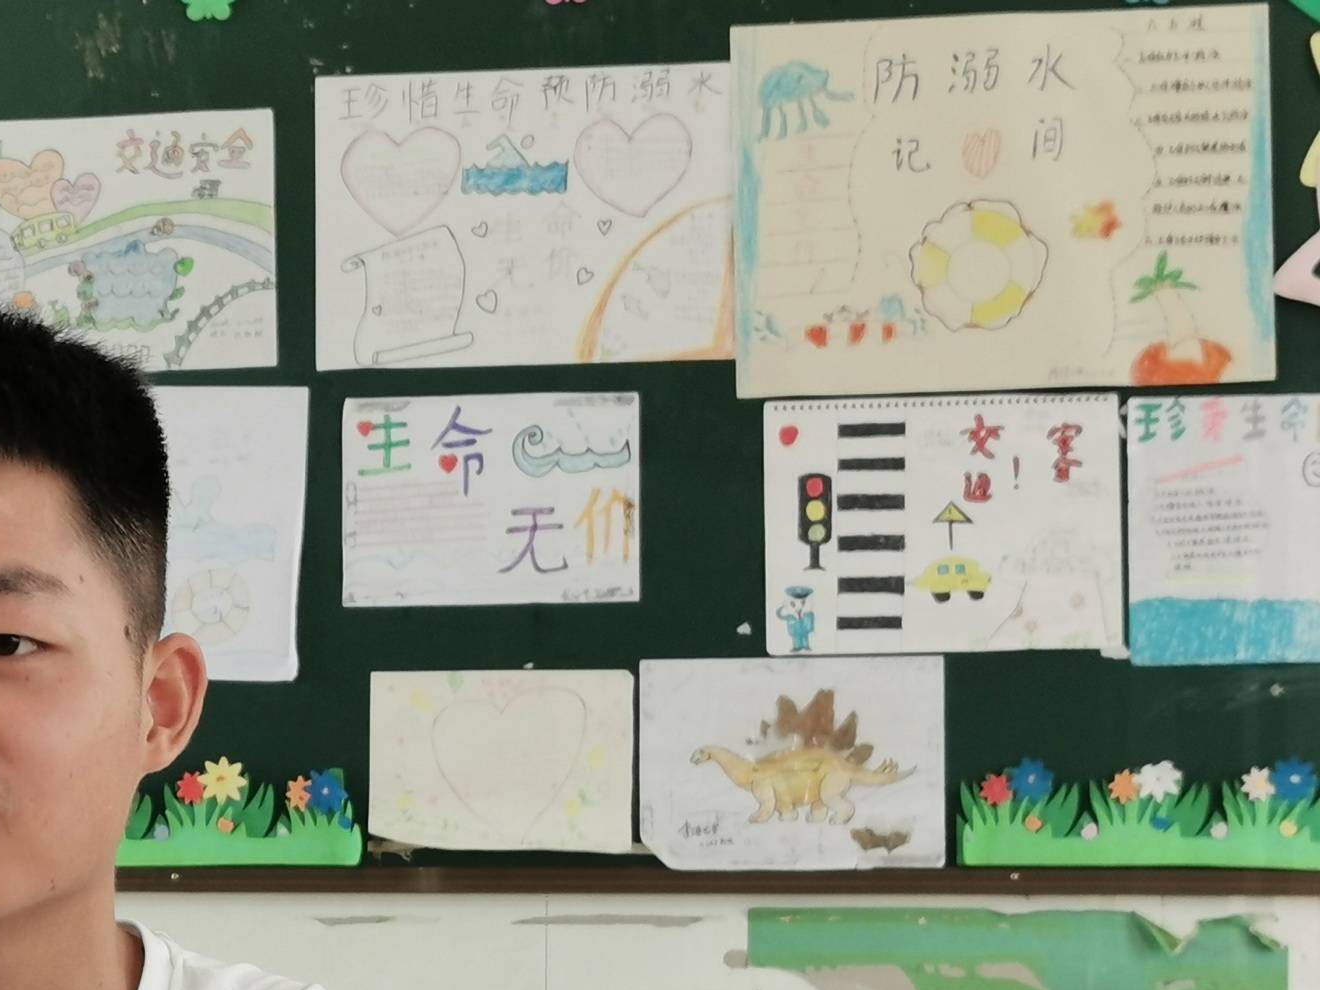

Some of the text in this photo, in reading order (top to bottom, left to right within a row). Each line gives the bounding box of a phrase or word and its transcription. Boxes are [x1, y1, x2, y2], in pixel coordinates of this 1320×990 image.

[338, 70, 722, 129] 珍惜生命预防溺水
[874, 44, 1076, 104] 防溺水
[116, 128, 254, 179] 交通安全
[891, 116, 1065, 174] 记 间
[1133, 395, 1320, 443] 珍爱生命
[356, 405, 493, 497] 生命
[496, 486, 636, 574] 无价
